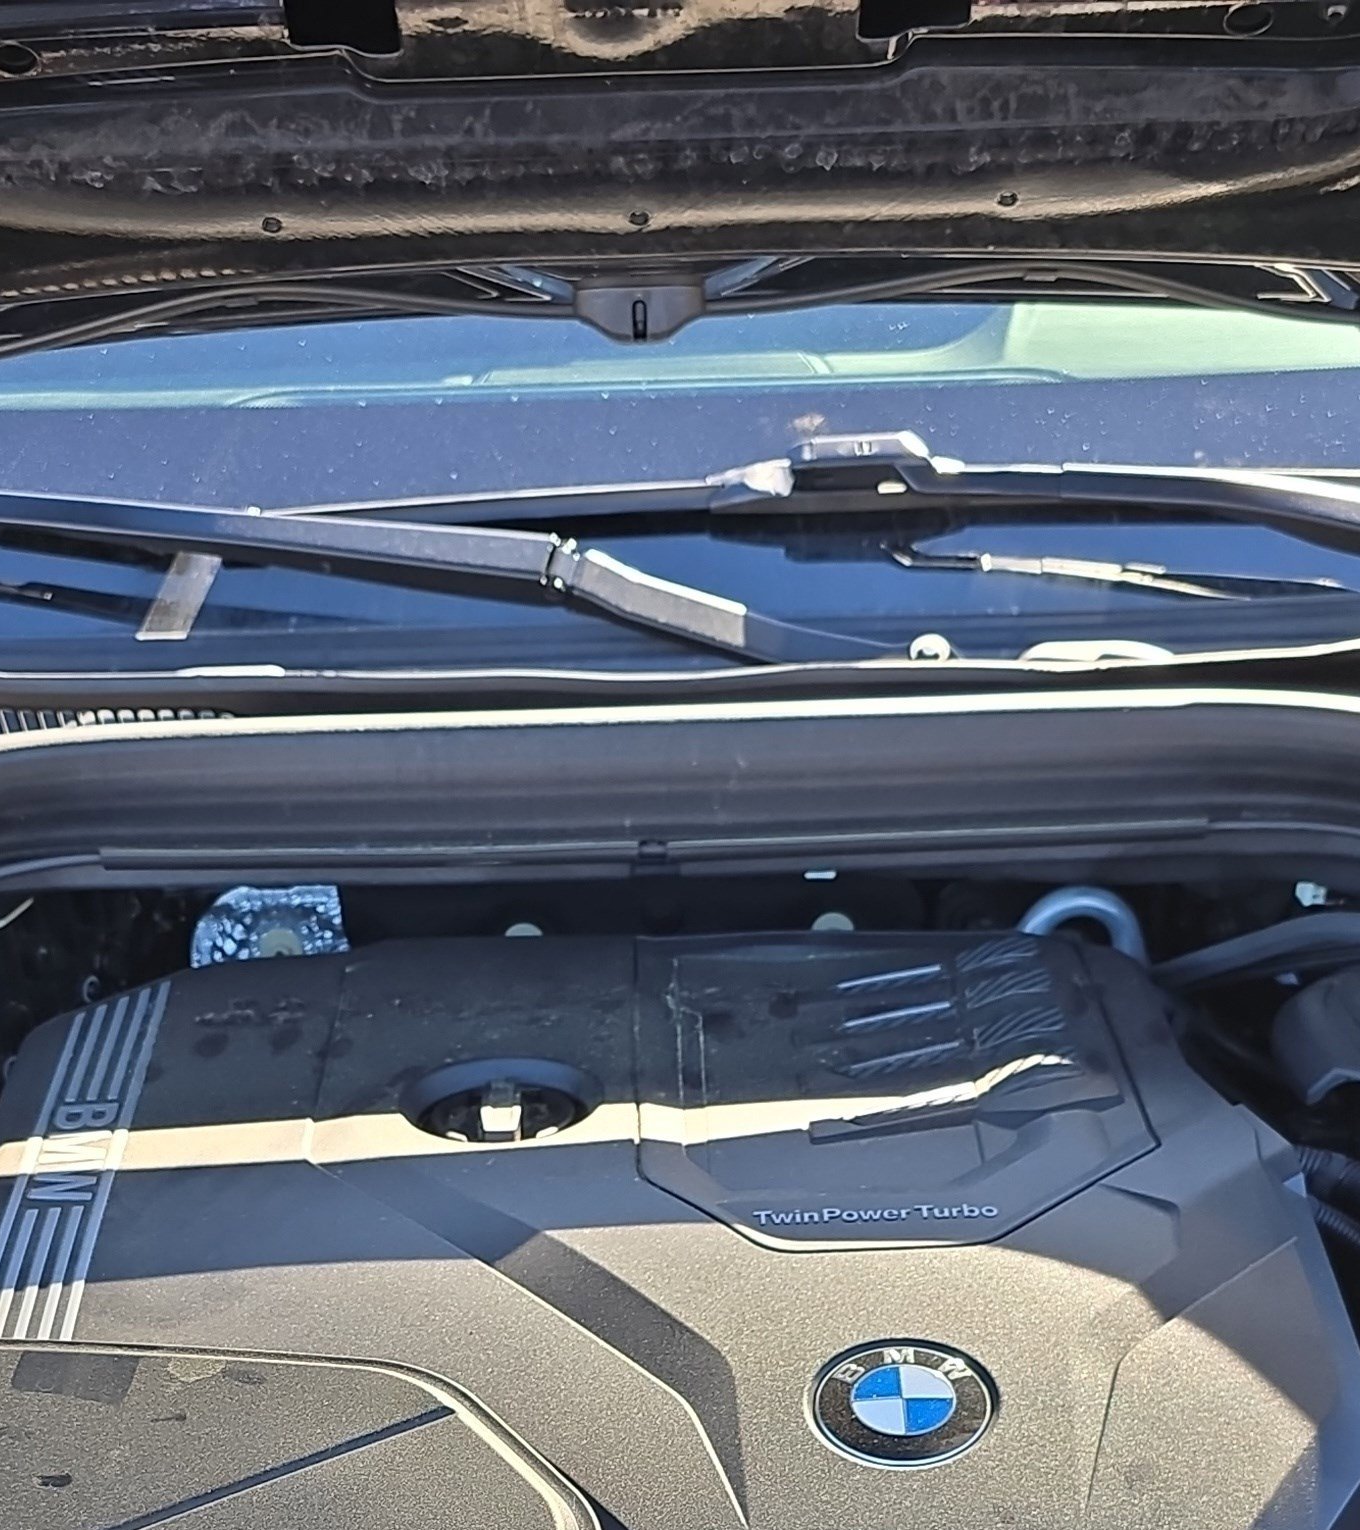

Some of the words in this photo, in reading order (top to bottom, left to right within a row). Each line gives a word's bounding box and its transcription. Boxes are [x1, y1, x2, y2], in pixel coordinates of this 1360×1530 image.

[27, 1102, 120, 1200] BMW
[752, 1207, 912, 1226] TwinPower
[913, 1203, 1000, 1220] Turbo
[830, 1348, 974, 1383] BMW
